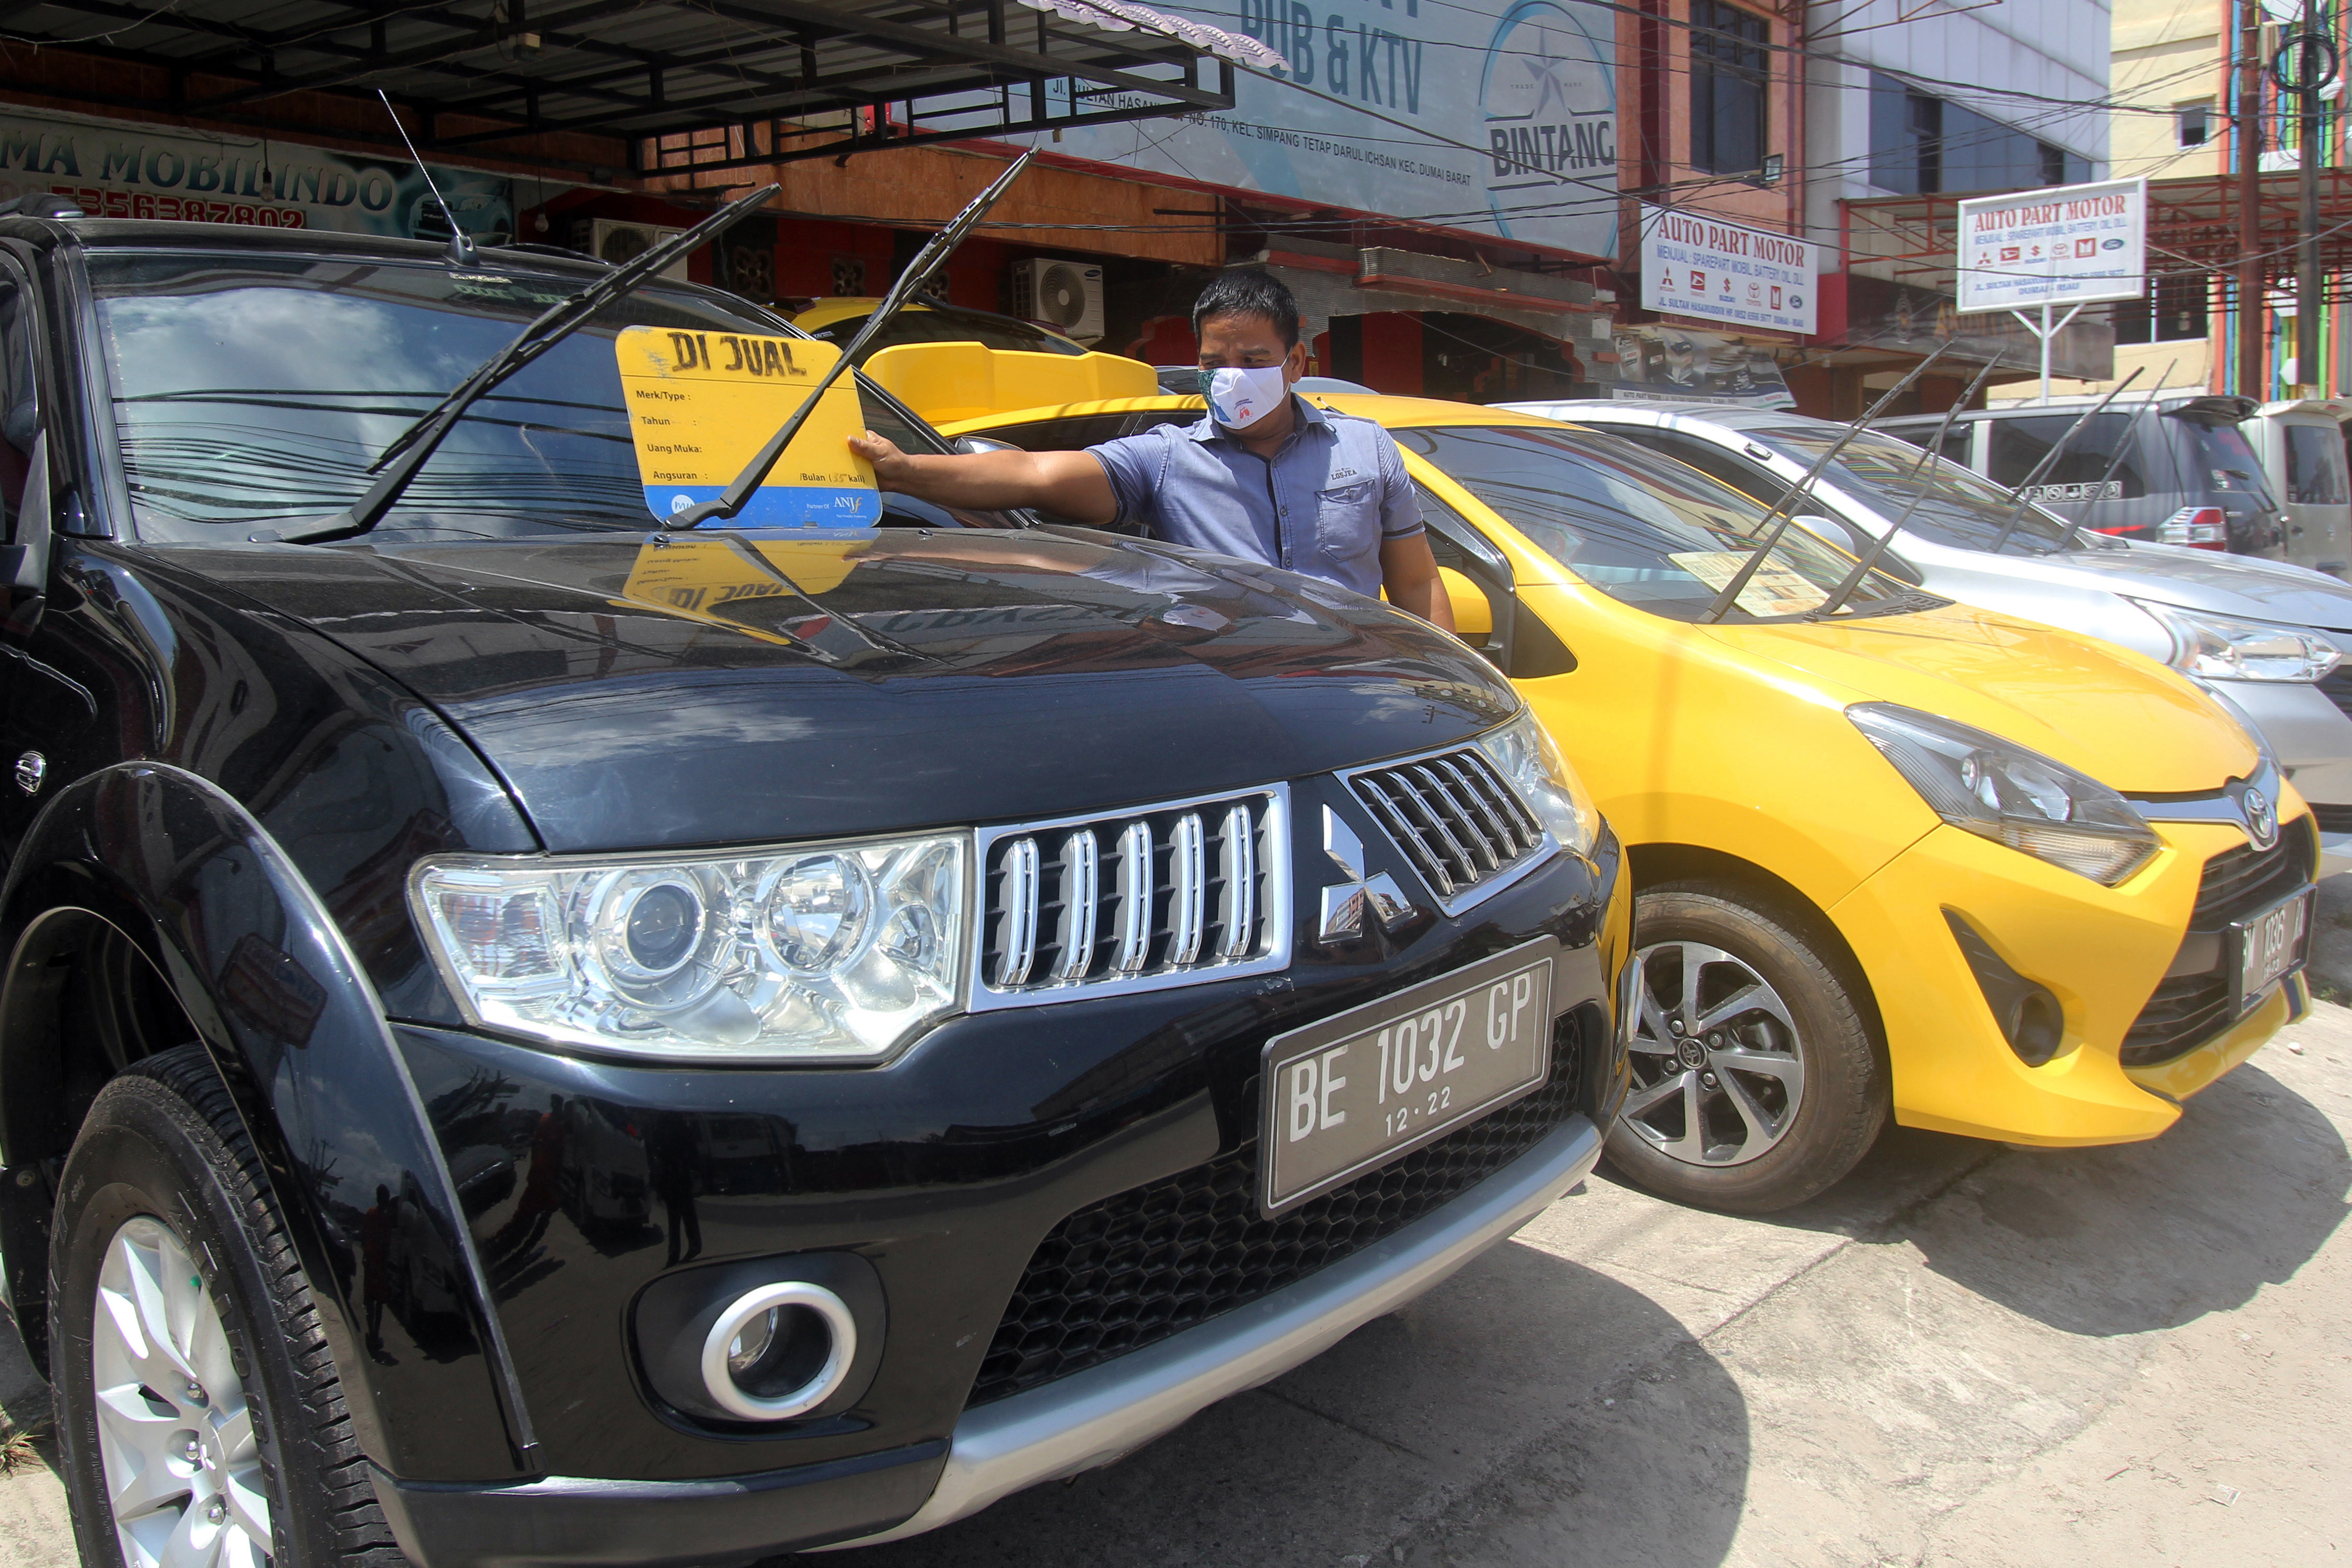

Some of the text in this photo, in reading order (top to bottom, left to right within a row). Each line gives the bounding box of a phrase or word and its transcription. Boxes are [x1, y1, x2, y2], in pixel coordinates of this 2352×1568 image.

[1327, 15, 1349, 96] &
[1359, 22, 1422, 115] KTV
[0, 130, 393, 211] MA MOBILINDO
[1210, 116, 1229, 134] 170,
[1232, 121, 1254, 137] KEL.
[1256, 127, 1299, 147] SIMPANG
[1304, 136, 1331, 153] TETAP
[1333, 143, 1363, 161] DARUL
[1365, 151, 1397, 169] ICHSAN
[1399, 158, 1418, 175] KEC.
[1420, 163, 1445, 178] DUMAI
[1447, 169, 1471, 187] BARAT
[1490, 120, 1615, 178] BINTANG
[1975, 195, 2126, 233] AUTO PART MOTOR
[1657, 214, 1805, 268] AUTO PART MOTOR
[1693, 252, 1730, 271] SPAREPART
[667, 332, 807, 377] DI JUAL
[636, 390, 685, 402] Merk/Type
[641, 416, 671, 426] Tahun
[647, 444, 702, 455] Uang Muka:
[653, 470, 698, 482] Angsuran
[800, 472, 826, 482] /Bulan
[2263, 908, 2285, 962] 1036
[1289, 971, 1531, 1143] BE 1032 GP
